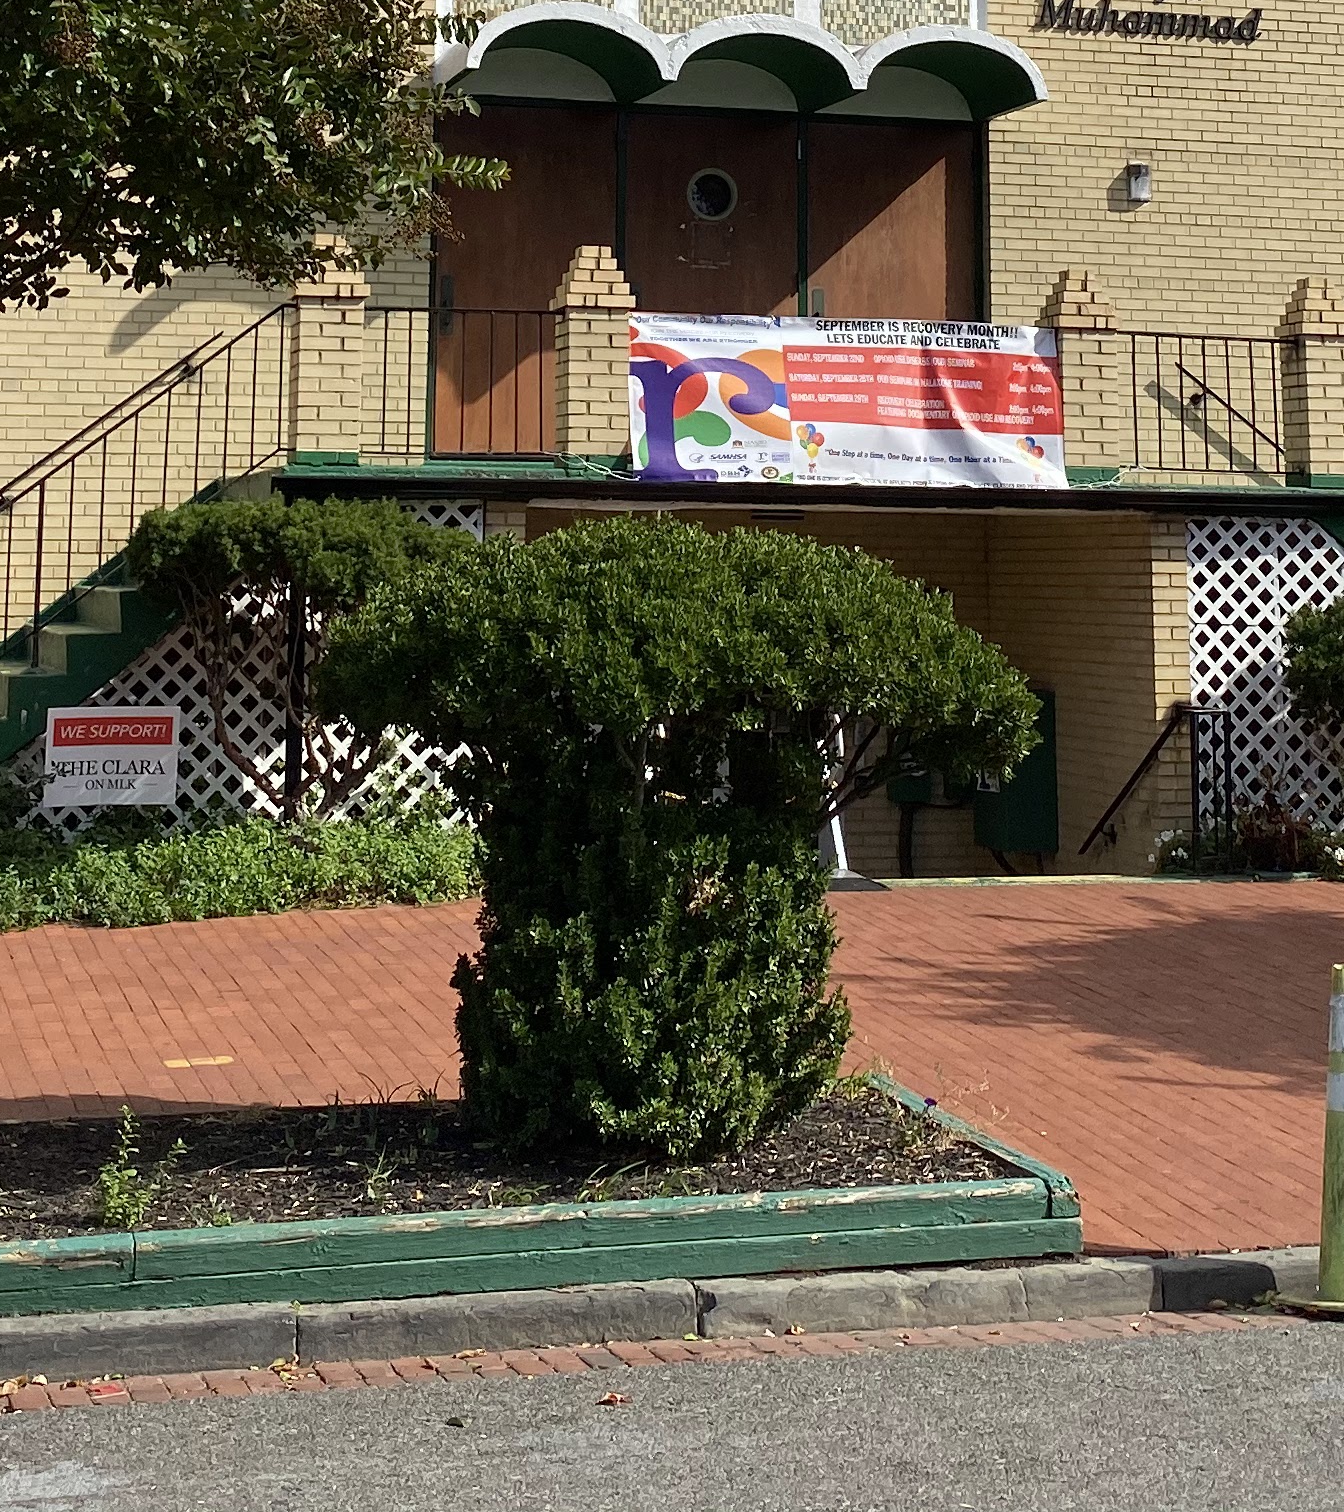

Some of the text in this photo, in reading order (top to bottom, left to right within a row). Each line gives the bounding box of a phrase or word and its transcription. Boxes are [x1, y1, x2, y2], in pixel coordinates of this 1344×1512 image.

[816, 320, 1018, 338] SEPTEMBER IS RECOVERY MONTH!!
[827, 334, 1001, 350] LETS EDUCATE AND CELEBRATE
[887, 452, 900, 460] One
[901, 453, 913, 462] Day
[982, 456, 991, 464] at
[60, 724, 167, 739] WE SUPPORT!
[56, 759, 166, 776] THE CLARA
[85, 778, 137, 791] ON MLK
